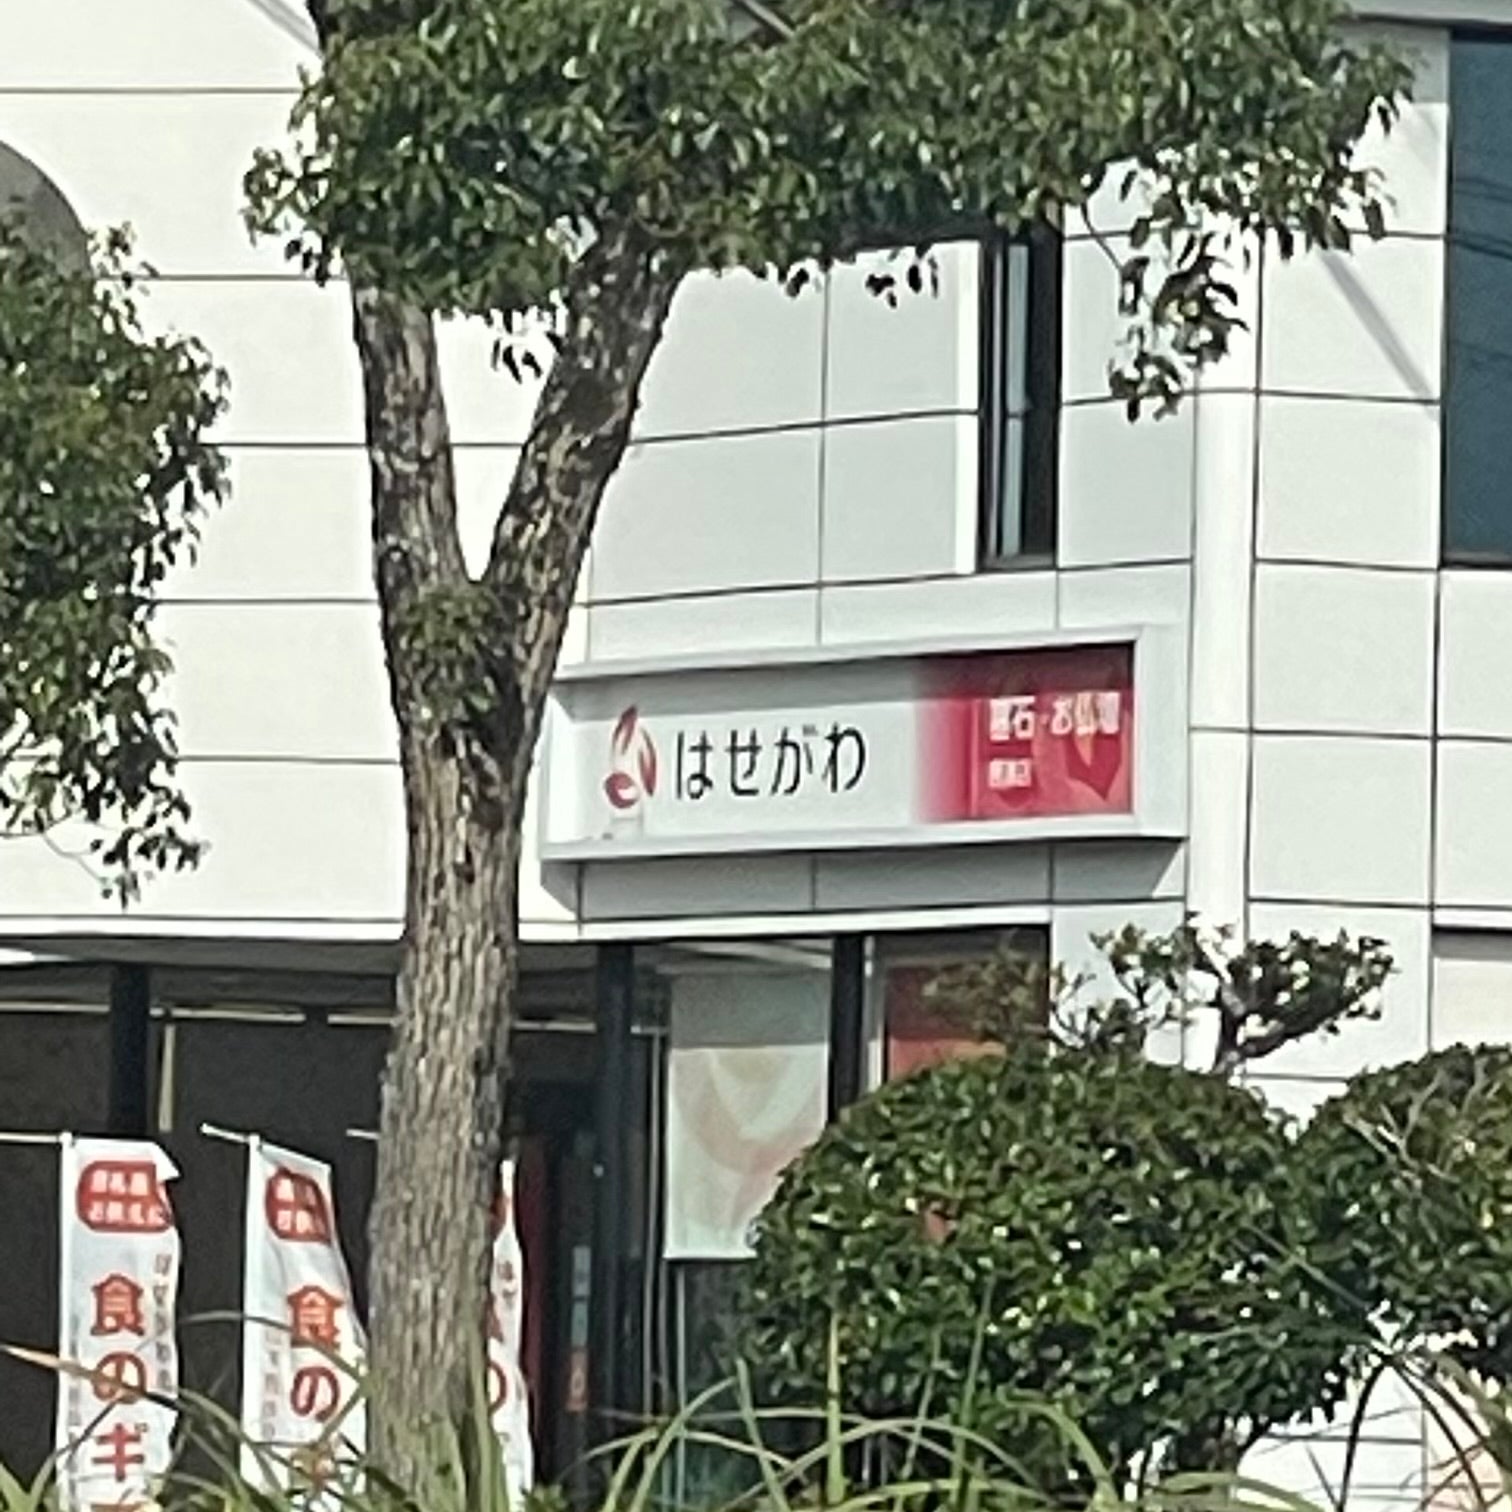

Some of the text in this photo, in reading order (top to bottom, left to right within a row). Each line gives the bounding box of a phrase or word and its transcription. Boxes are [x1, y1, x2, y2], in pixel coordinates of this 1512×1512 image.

[674, 723, 867, 801] はせがわ
[90, 1273, 146, 1512] 食のギ
